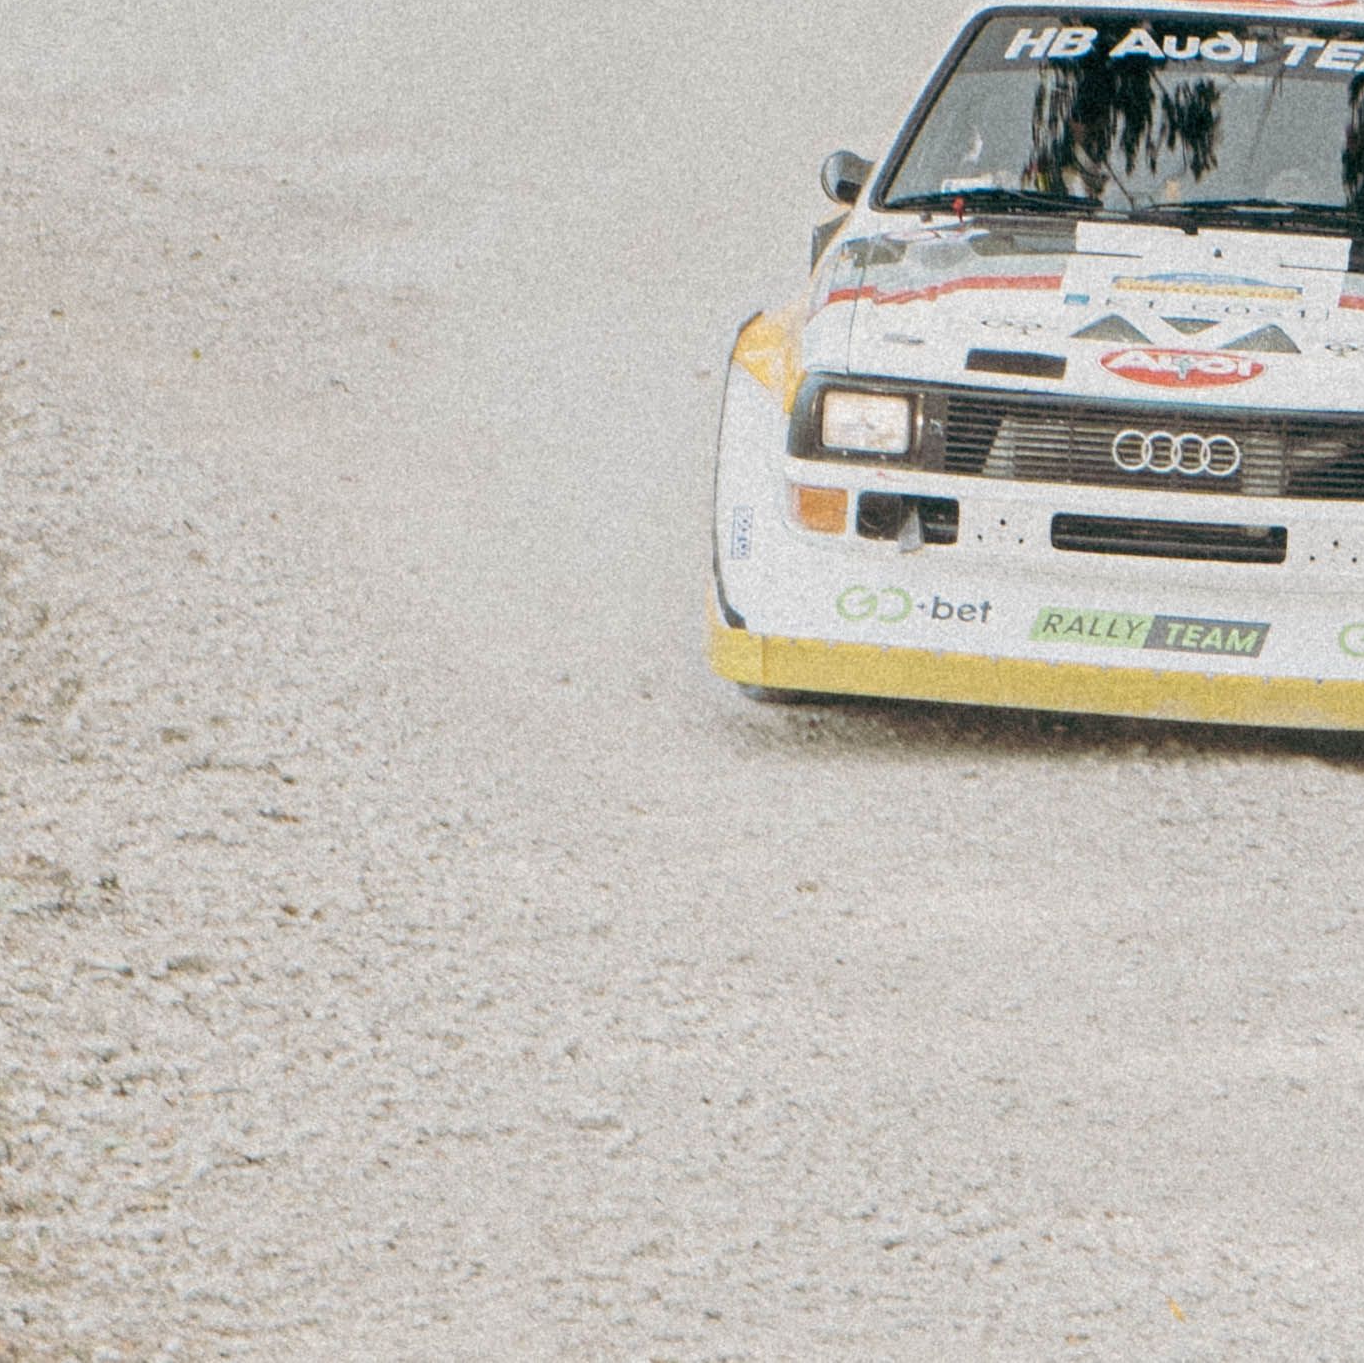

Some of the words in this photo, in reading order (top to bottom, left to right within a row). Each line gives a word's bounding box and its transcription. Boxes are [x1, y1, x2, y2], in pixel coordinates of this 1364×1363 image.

[1003, 26, 1099, 61] HB
[1108, 27, 1258, 64] Audi
[1041, 613, 1147, 642] RALLY
[1164, 621, 1261, 654] TEAM
